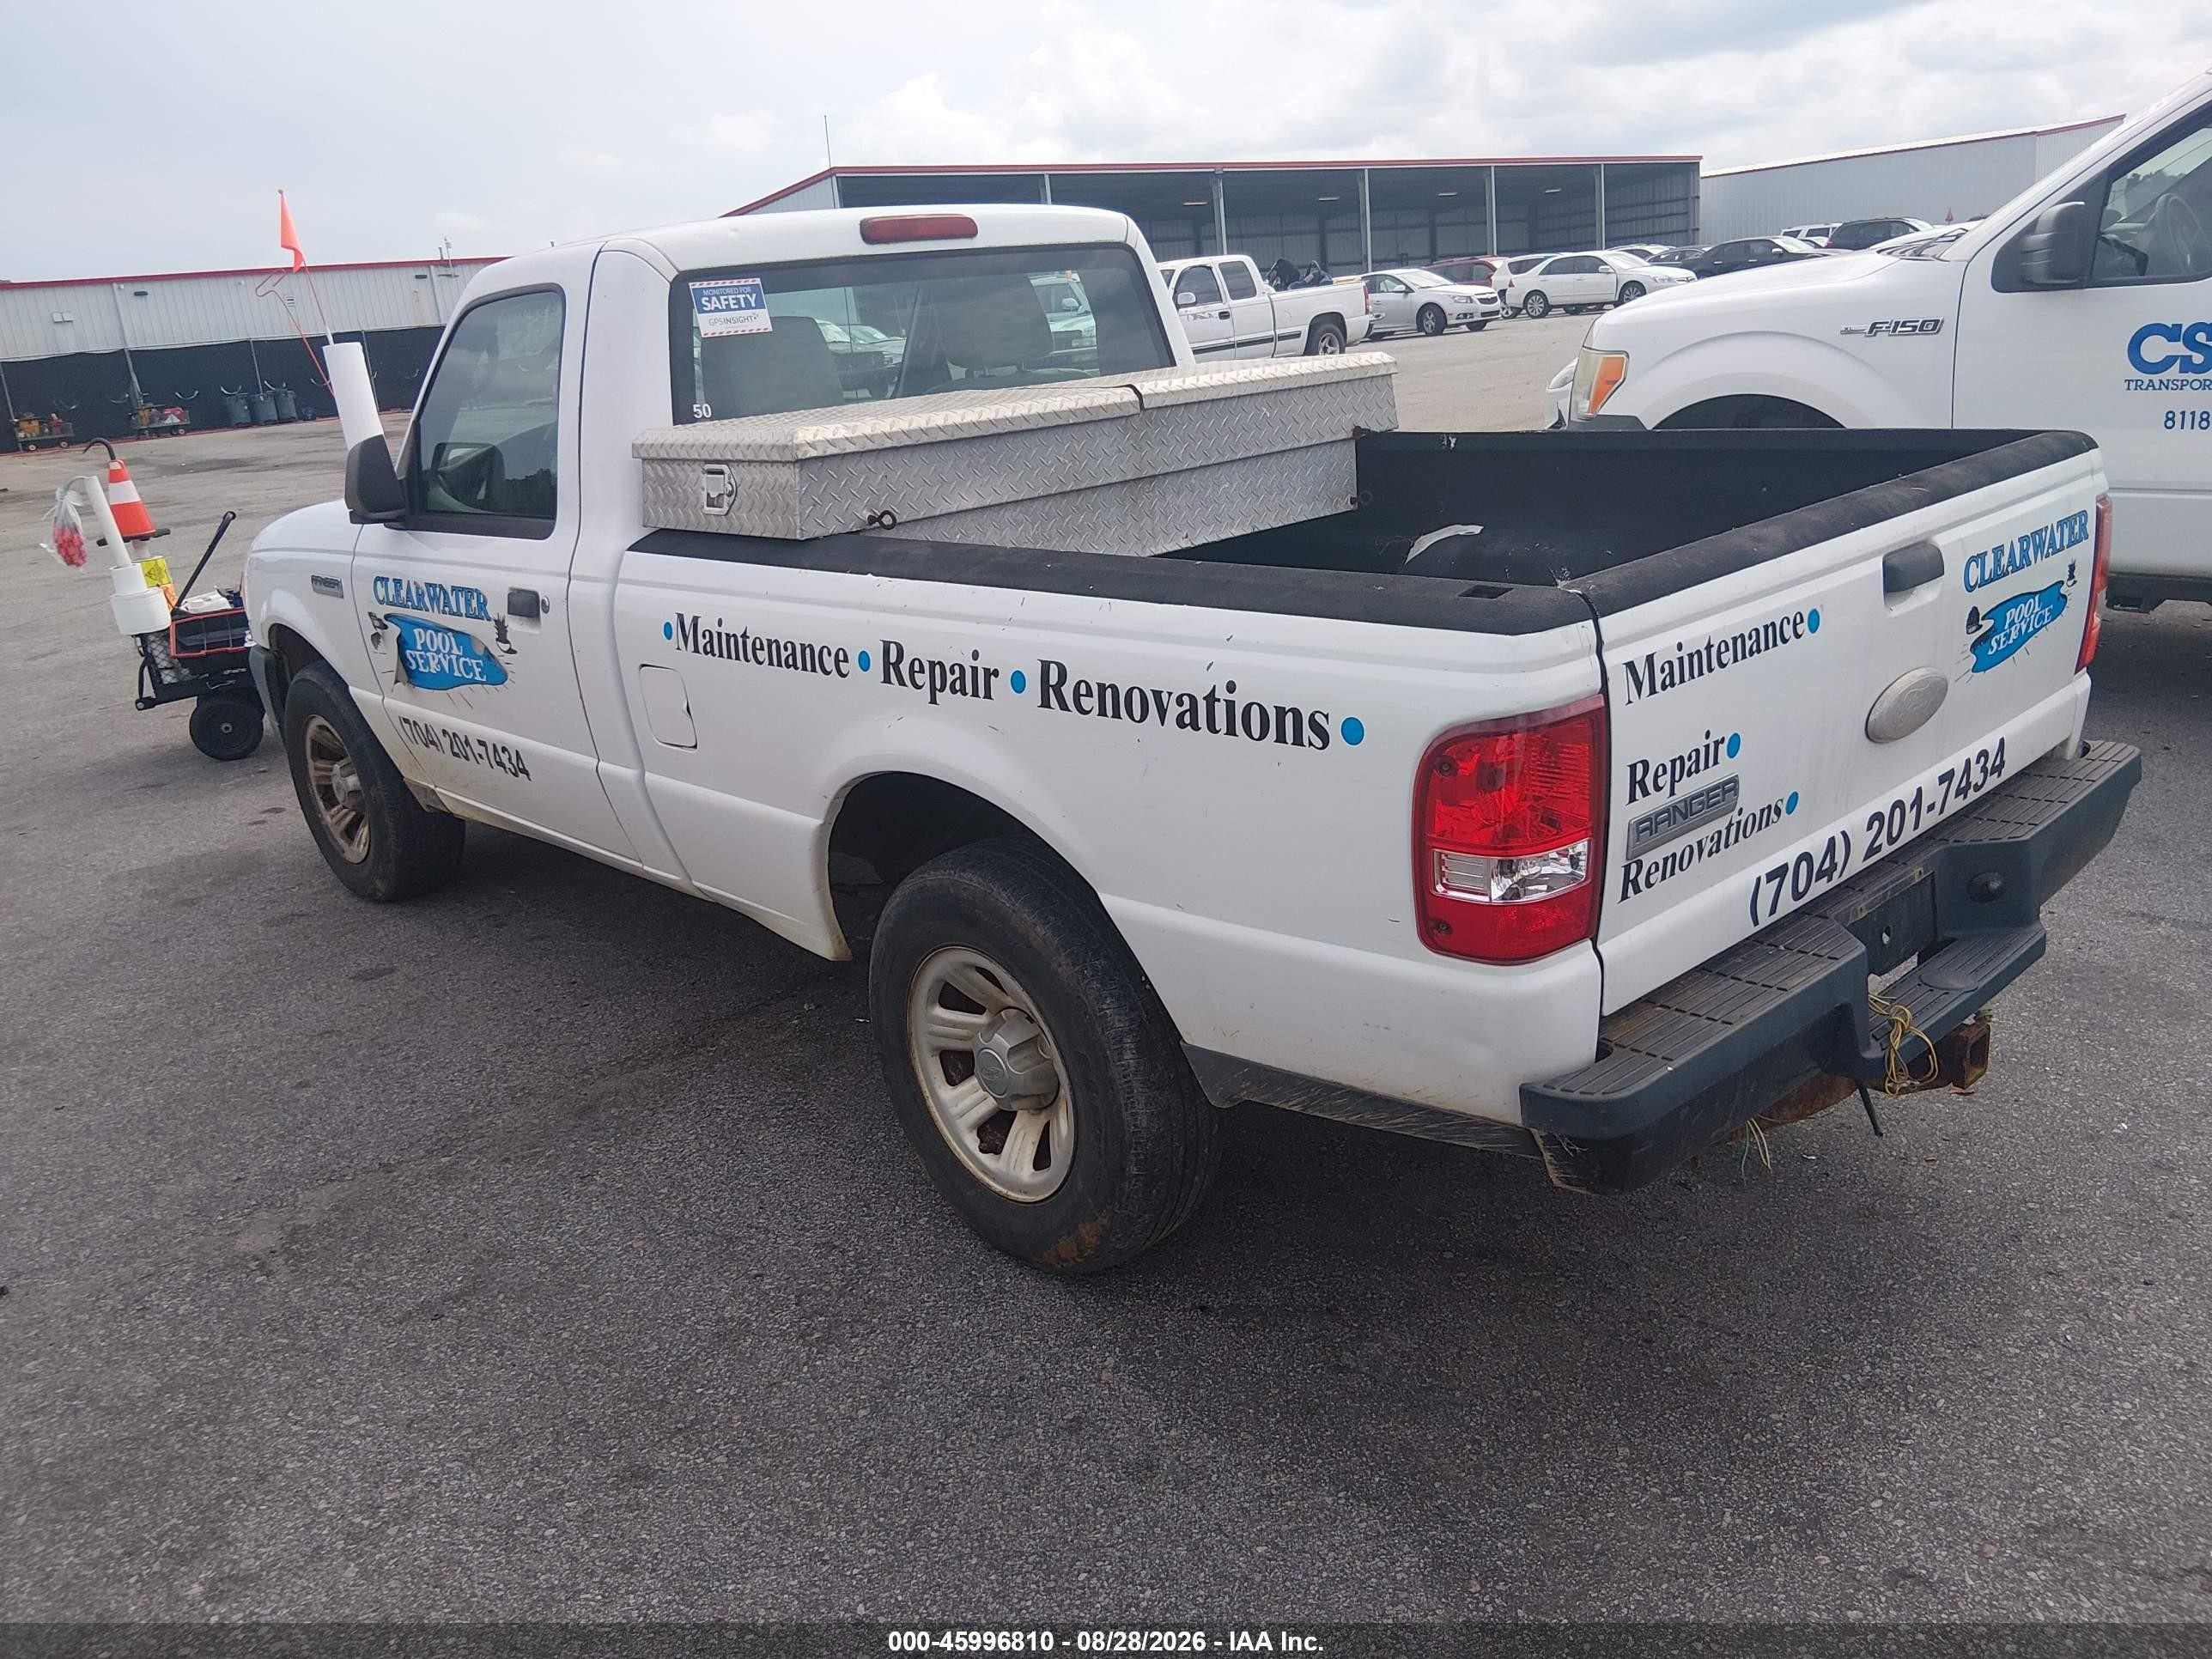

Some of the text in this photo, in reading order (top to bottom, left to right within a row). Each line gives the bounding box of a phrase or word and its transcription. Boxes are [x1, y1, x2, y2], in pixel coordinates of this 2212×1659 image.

[702, 294, 757, 311] SAFETY
[1867, 319, 1942, 335] F-150
[2124, 379, 2212, 391] TRANSPOR
[693, 404, 712, 418] 50
[2164, 410, 2210, 430] 8118
[1963, 509, 2089, 592] CLEARWATER
[374, 576, 492, 621] CLEARWATER
[2004, 593, 2044, 629] POOL
[413, 629, 464, 656] POOL
[1987, 605, 2054, 655] SERVICE
[406, 652, 487, 682] SERVICE
[676, 612, 1330, 751] Maintenance Repair Renovations
[1622, 611, 1805, 705] Maintenance
[398, 715, 532, 781] (704) 201-7434
[1626, 730, 1725, 806] Repair
[1635, 776, 1738, 843] RANGER
[1749, 736, 2006, 927] (704) 201-7434
[1617, 796, 1784, 904] Renovations
